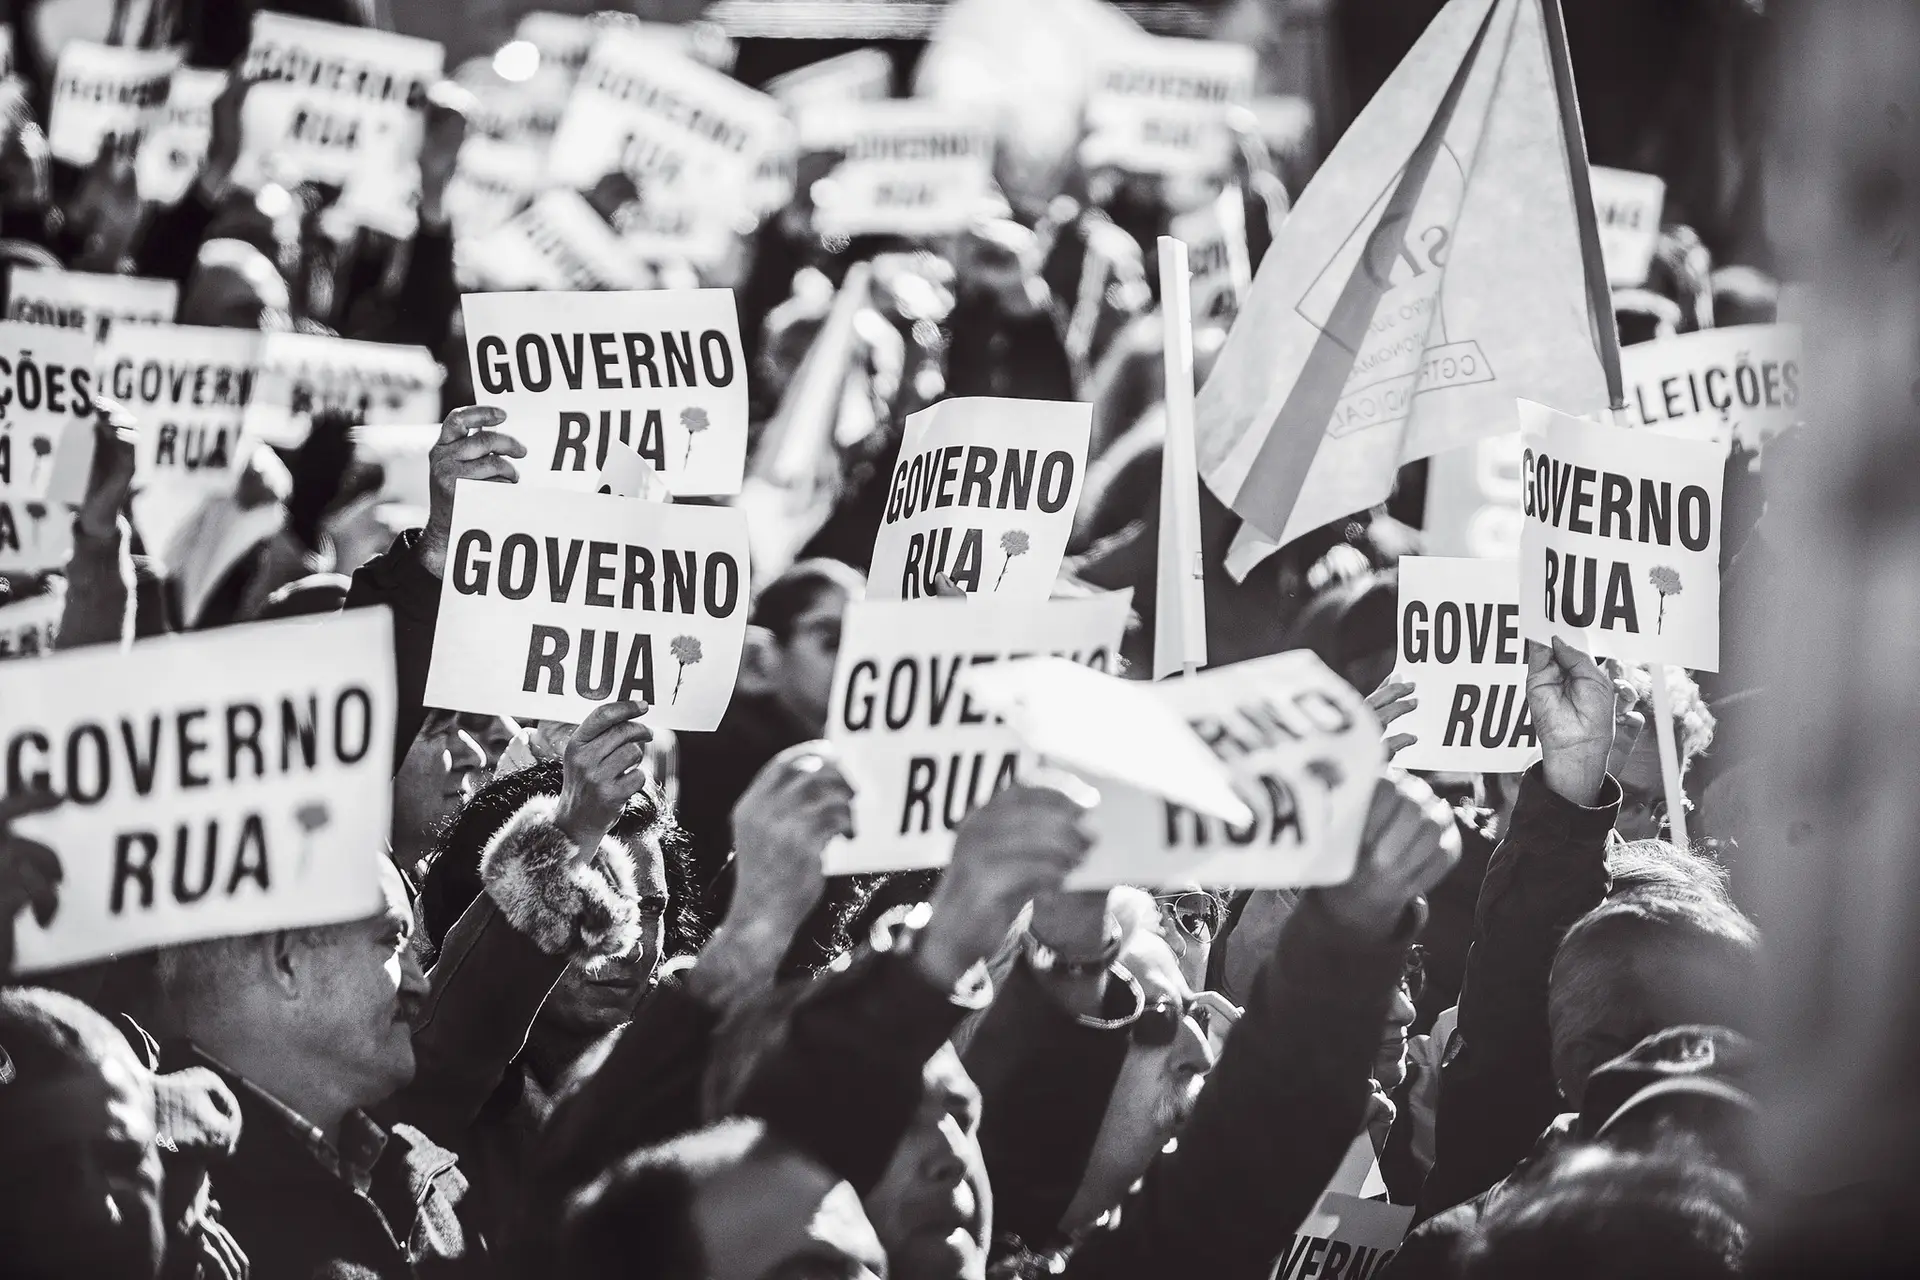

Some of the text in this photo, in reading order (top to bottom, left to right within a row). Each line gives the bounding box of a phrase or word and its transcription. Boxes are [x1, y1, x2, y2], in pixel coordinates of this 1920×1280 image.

[113, 358, 259, 405] GOVERN
[477, 329, 734, 395] GOVERNO
[1634, 350, 1800, 425] LEIÇÕES
[155, 420, 229, 472] RUA
[550, 409, 666, 472] RUA
[887, 445, 1075, 525] GOVERNO
[1522, 447, 1712, 552] GOVERNO
[452, 528, 739, 619] GOVERNO
[902, 527, 983, 602] RUA
[1544, 546, 1640, 634] RUA
[522, 623, 656, 706] RUA
[1403, 600, 1529, 665] GOVE
[6, 686, 372, 806] GOVERNO
[109, 813, 271, 916] RUA
[1275, 1235, 1397, 1280] VERN
